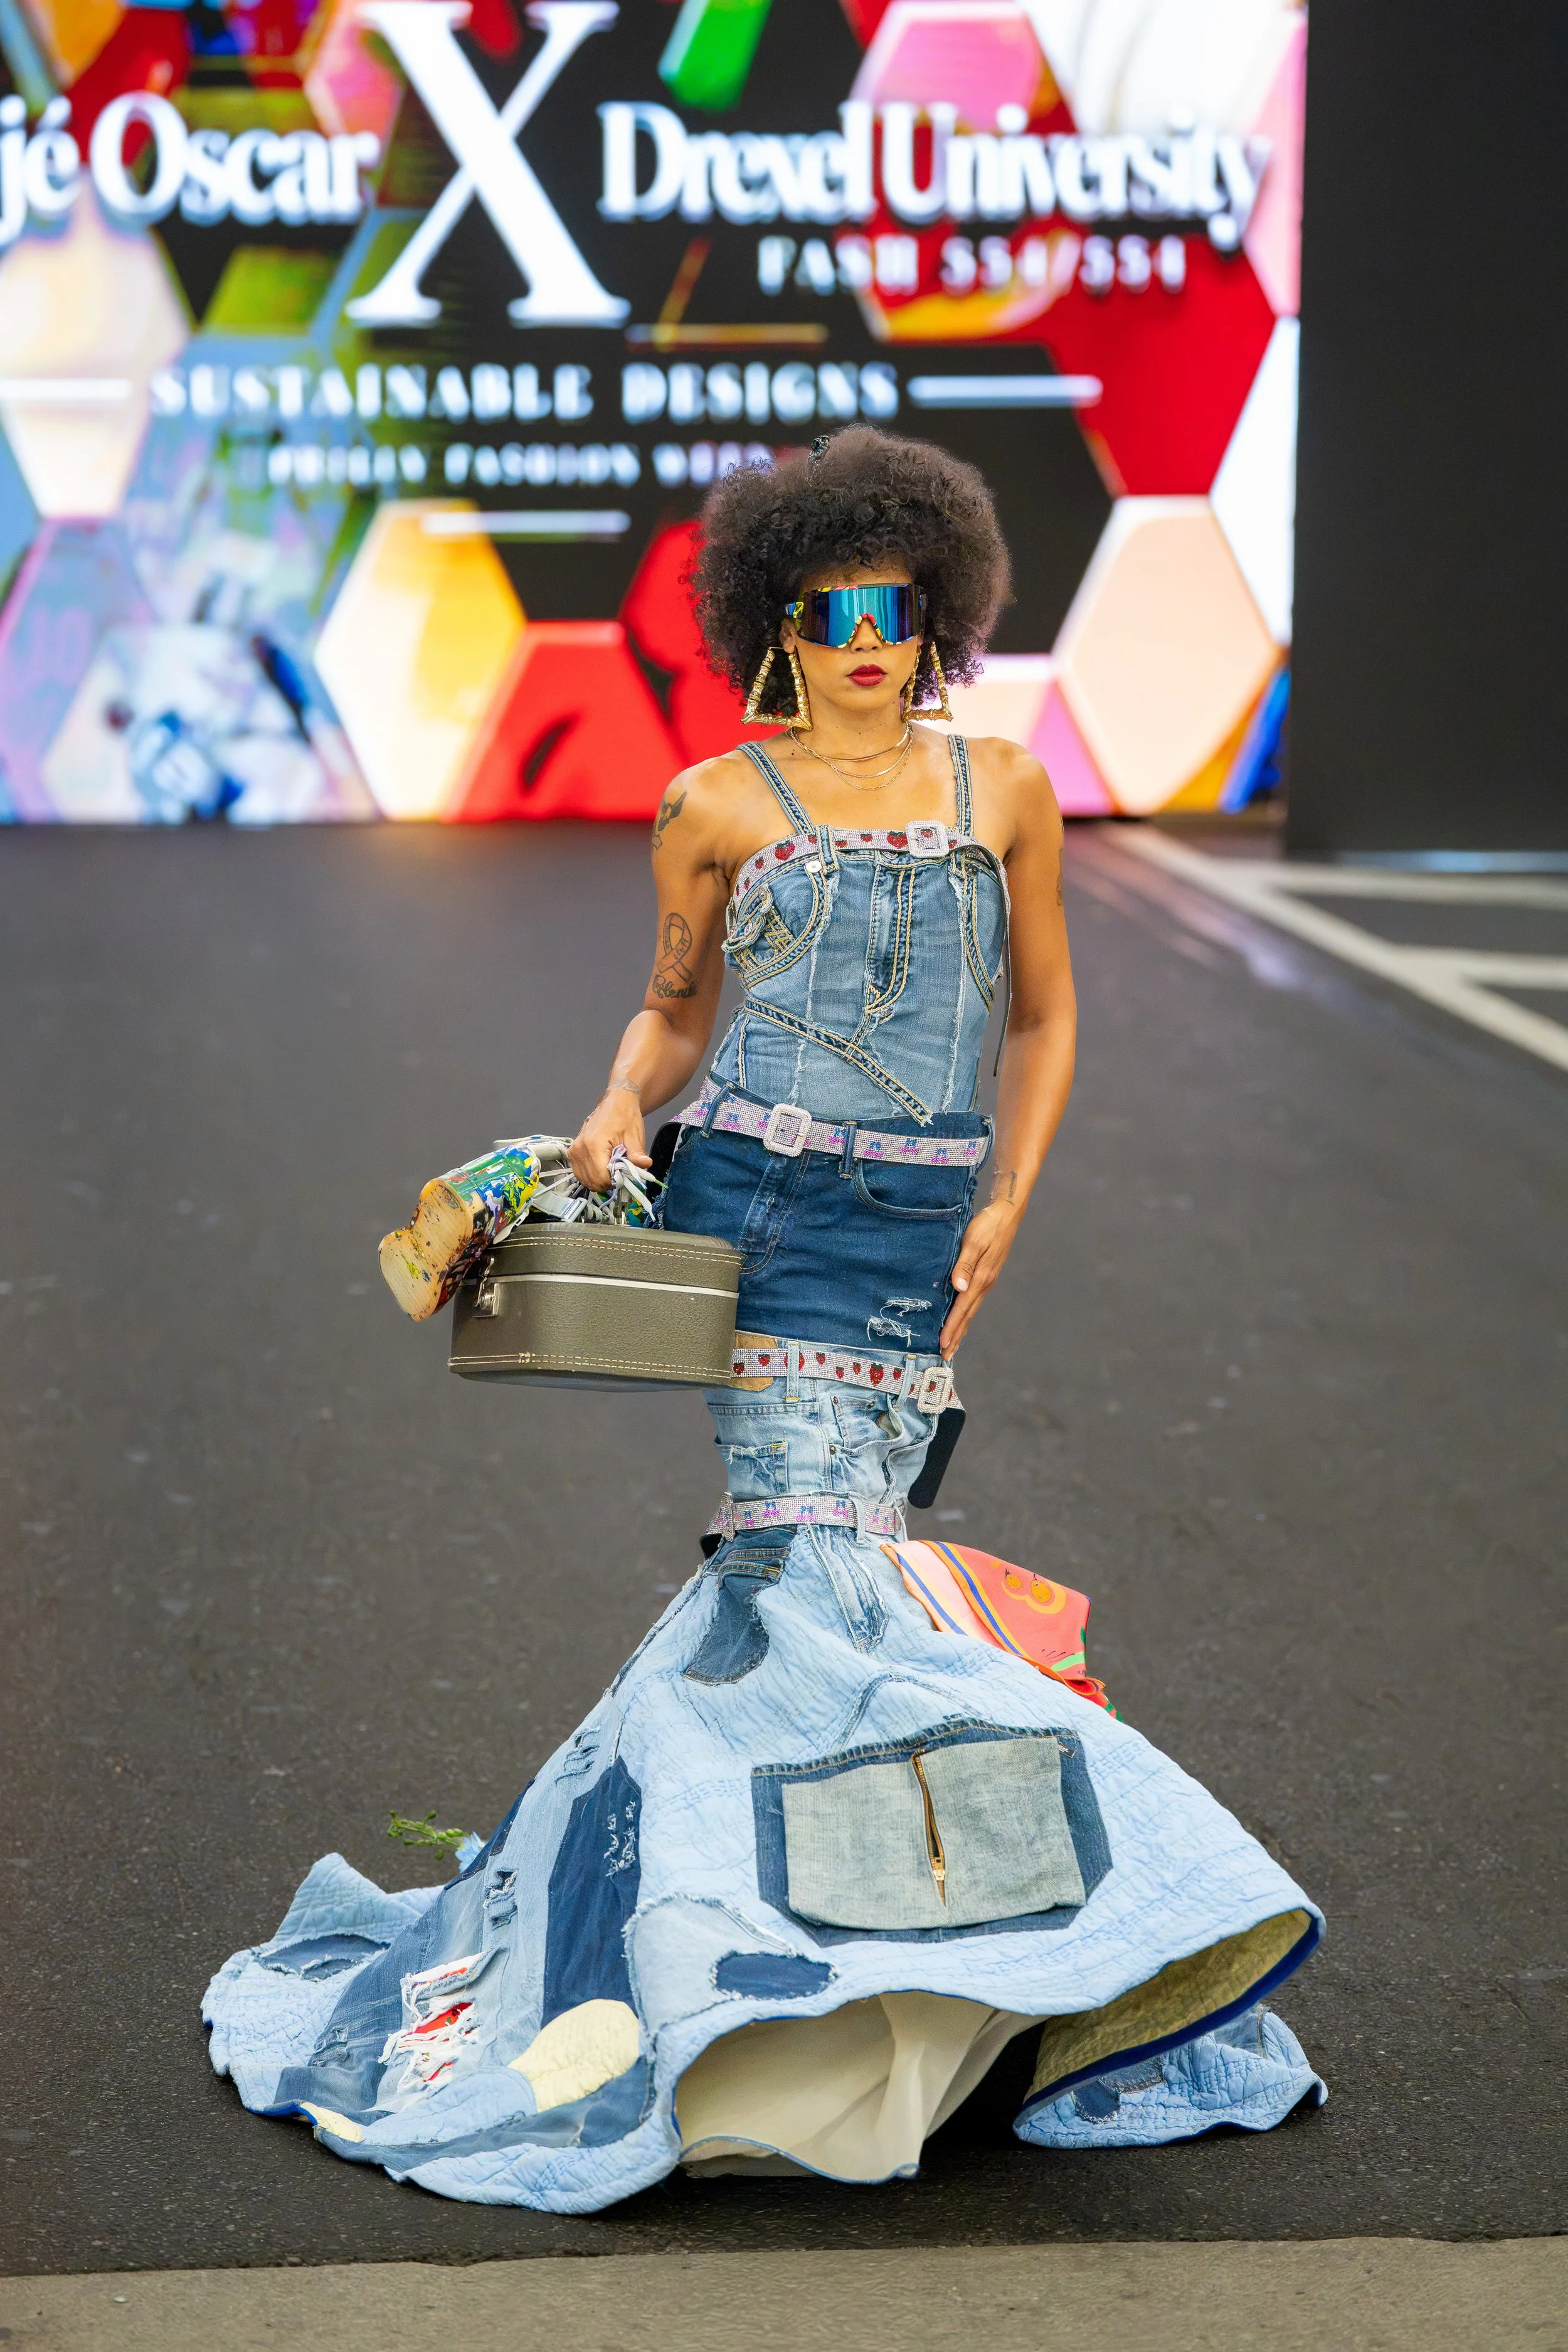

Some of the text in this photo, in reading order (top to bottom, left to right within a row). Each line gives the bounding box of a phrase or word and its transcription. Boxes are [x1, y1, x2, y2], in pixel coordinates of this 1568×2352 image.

[90, 90, 380, 225] Oscar
[346, 0, 630, 326] X
[596, 100, 878, 225] Drexel
[881, 100, 1272, 251] University
[149, 361, 899, 425] SUSTAINABLE DESIGNS
